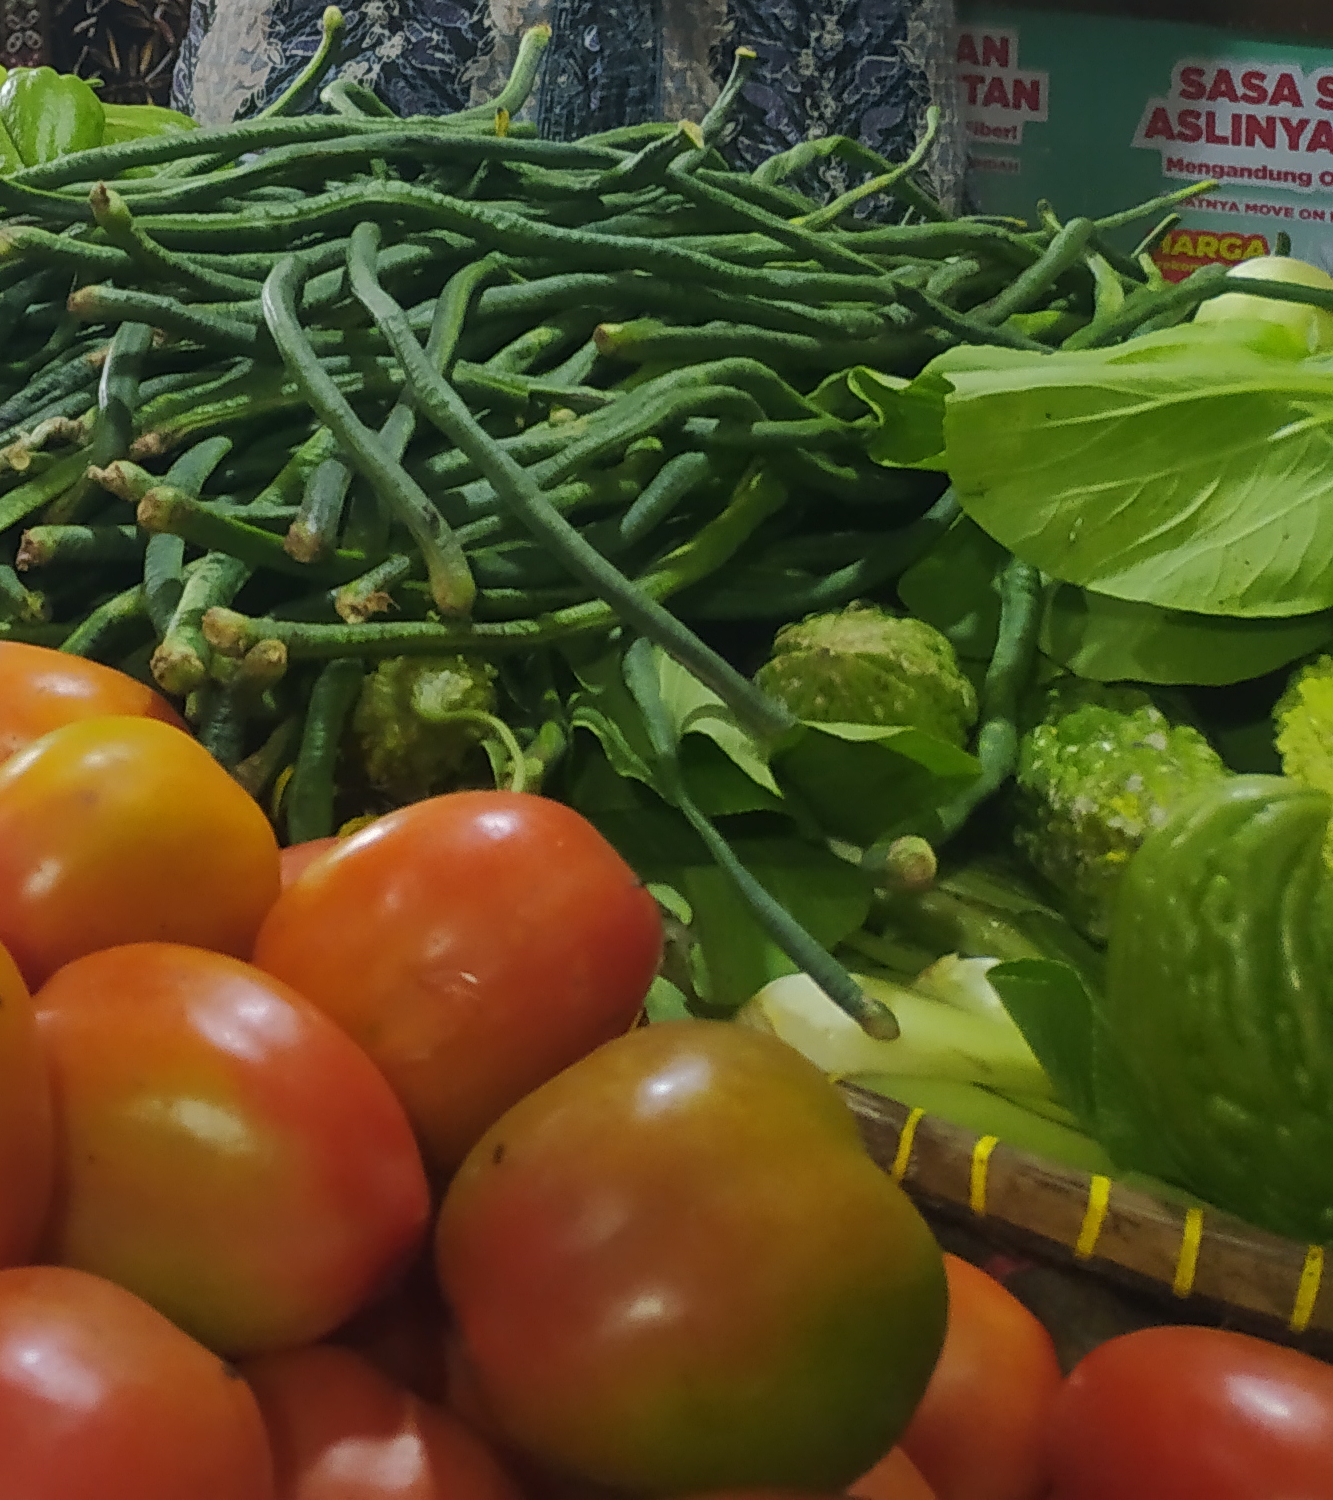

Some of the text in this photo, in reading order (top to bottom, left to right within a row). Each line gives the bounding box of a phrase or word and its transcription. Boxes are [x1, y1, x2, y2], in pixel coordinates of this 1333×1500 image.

[957, 33, 1010, 68] AN
[960, 74, 1041, 112] TAN
[1179, 66, 1333, 111] SASA S
[1144, 106, 1333, 154] ASLINYA
[1166, 157, 1313, 188] Mengandung
[1183, 197, 1326, 221] ATNYA MOVE ON
